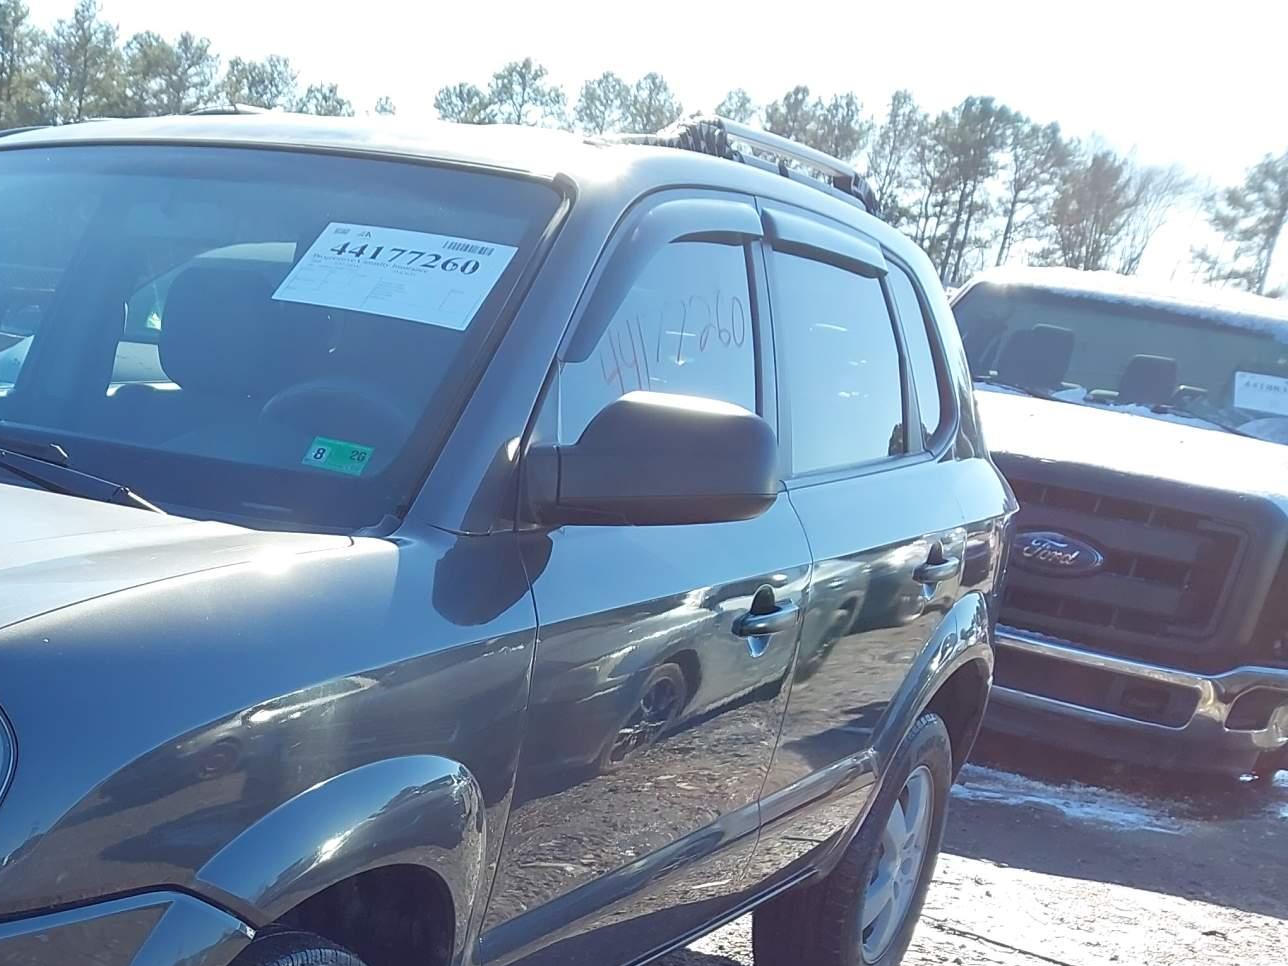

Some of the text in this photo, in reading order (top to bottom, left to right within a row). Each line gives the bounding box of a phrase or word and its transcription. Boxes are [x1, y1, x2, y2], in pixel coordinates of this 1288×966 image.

[329, 241, 481, 275] 44177260
[313, 447, 327, 460] 8
[1022, 539, 1081, 565] Ford
